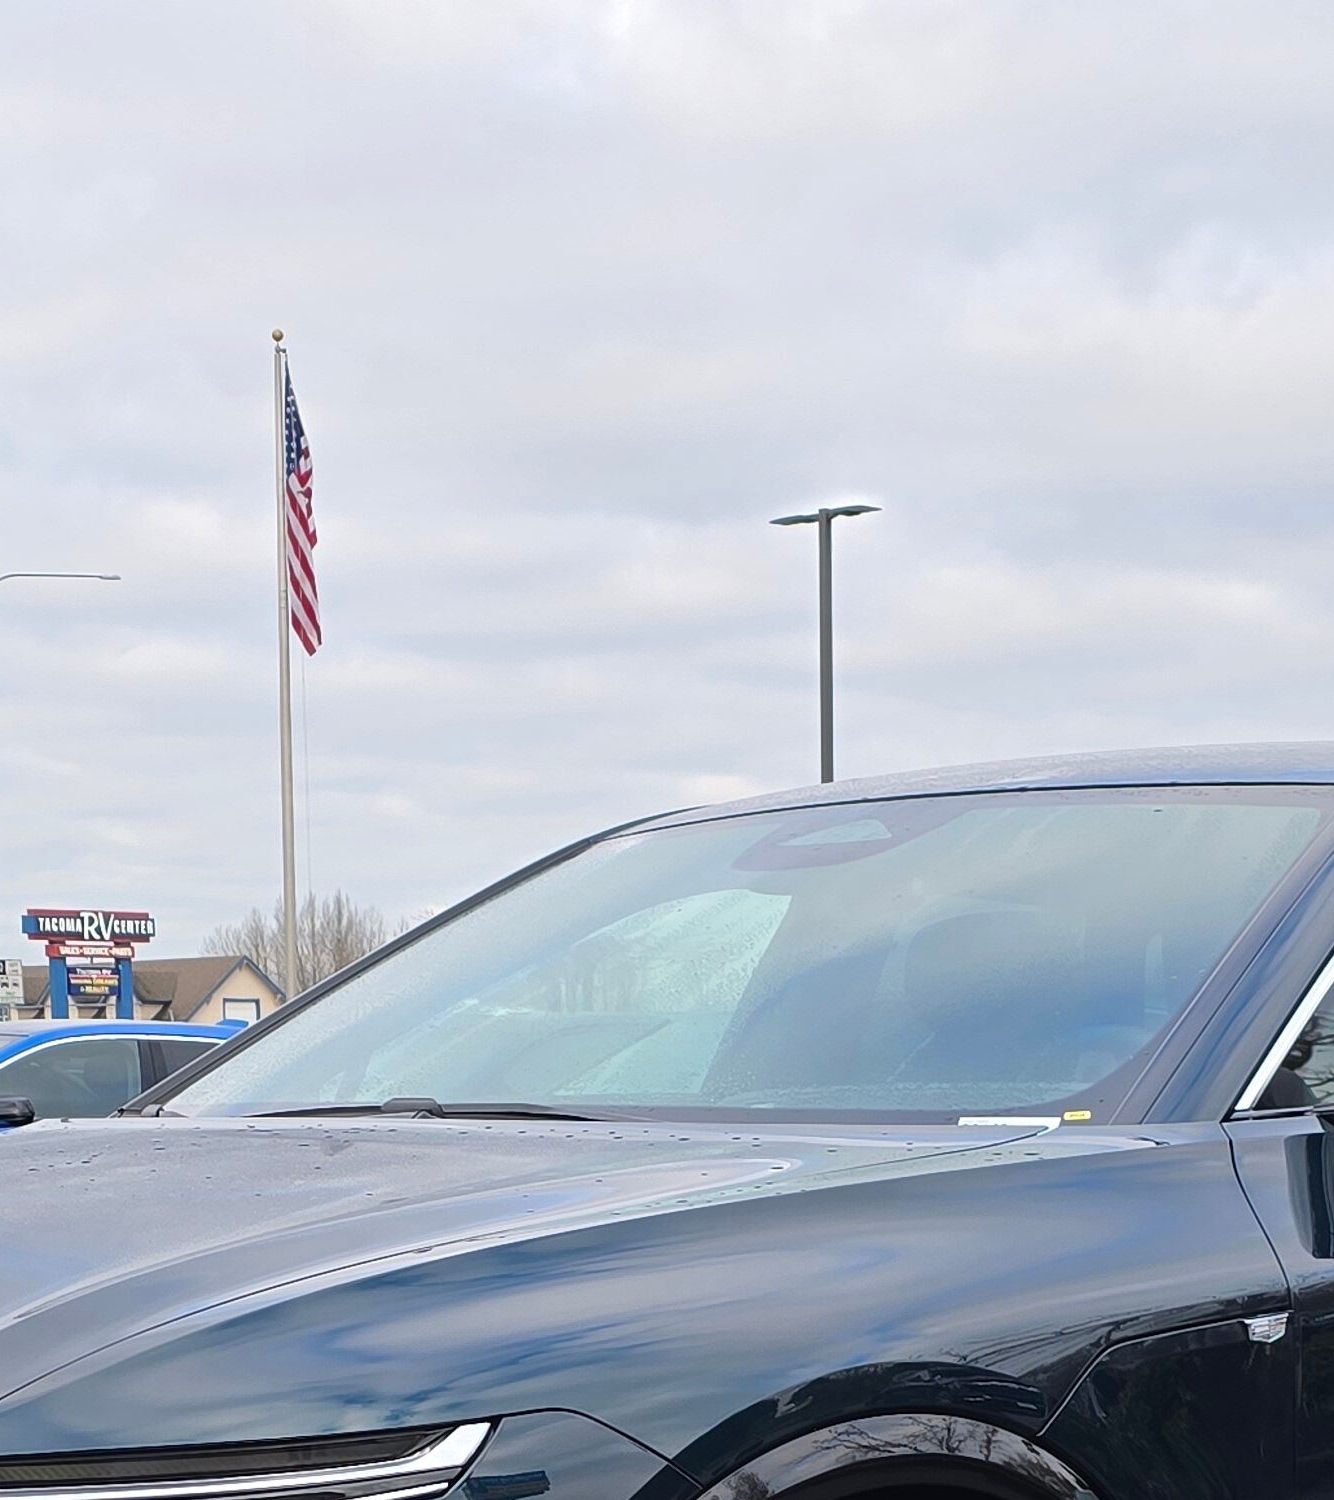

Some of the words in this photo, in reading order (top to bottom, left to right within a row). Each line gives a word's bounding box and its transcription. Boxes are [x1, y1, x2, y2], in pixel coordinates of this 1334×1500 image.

[38, 917, 83, 934] TACOMA
[80, 911, 116, 941] RV
[113, 918, 154, 935] CENTER
